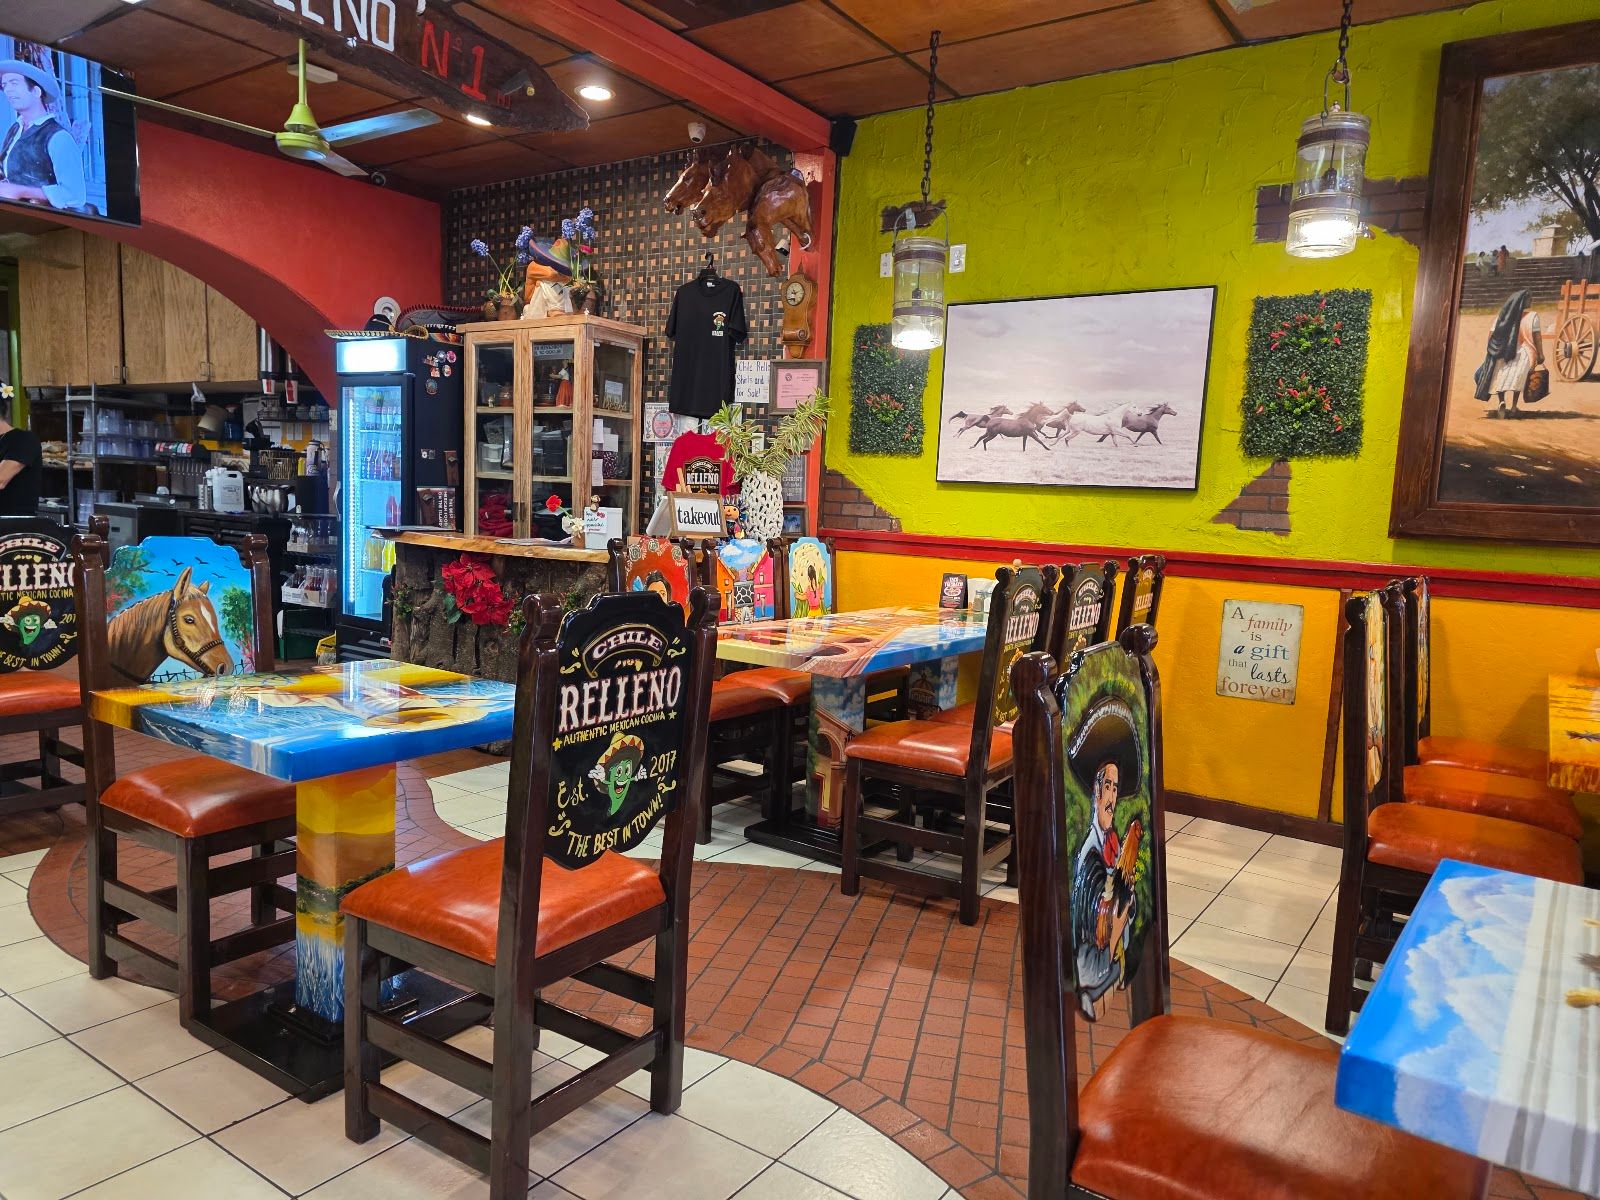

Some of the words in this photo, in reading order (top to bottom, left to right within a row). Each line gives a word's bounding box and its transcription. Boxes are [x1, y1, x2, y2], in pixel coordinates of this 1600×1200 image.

[461, 46, 487, 101] 1
[738, 361, 753, 372] Chile
[736, 375, 753, 385] Shirts
[754, 376, 765, 385] and
[736, 389, 744, 397] For
[747, 388, 761, 398] Sale!
[49, 588, 74, 600] COCINA
[1231, 606, 1244, 620] A
[1241, 613, 1293, 637] family
[1250, 631, 1262, 642] is
[31, 657, 40, 667] IN
[40, 644, 66, 664] TOWN!
[592, 630, 663, 659] CHILE
[1233, 645, 1246, 655] a
[1250, 644, 1290, 661] gift
[1228, 658, 1247, 668] that
[1250, 662, 1292, 684] lasts
[558, 665, 682, 733] RELLENO
[1221, 676, 1293, 699] forever
[563, 725, 608, 747] AUTHENTIC
[609, 715, 642, 732] MEXICAN
[640, 710, 666, 725] COCINA
[557, 775, 589, 809] Est.
[649, 749, 677, 778] 2017
[566, 831, 592, 858] THE
[593, 827, 621, 855] BEST
[622, 823, 632, 844] IN
[631, 792, 664, 834] TOWN!
